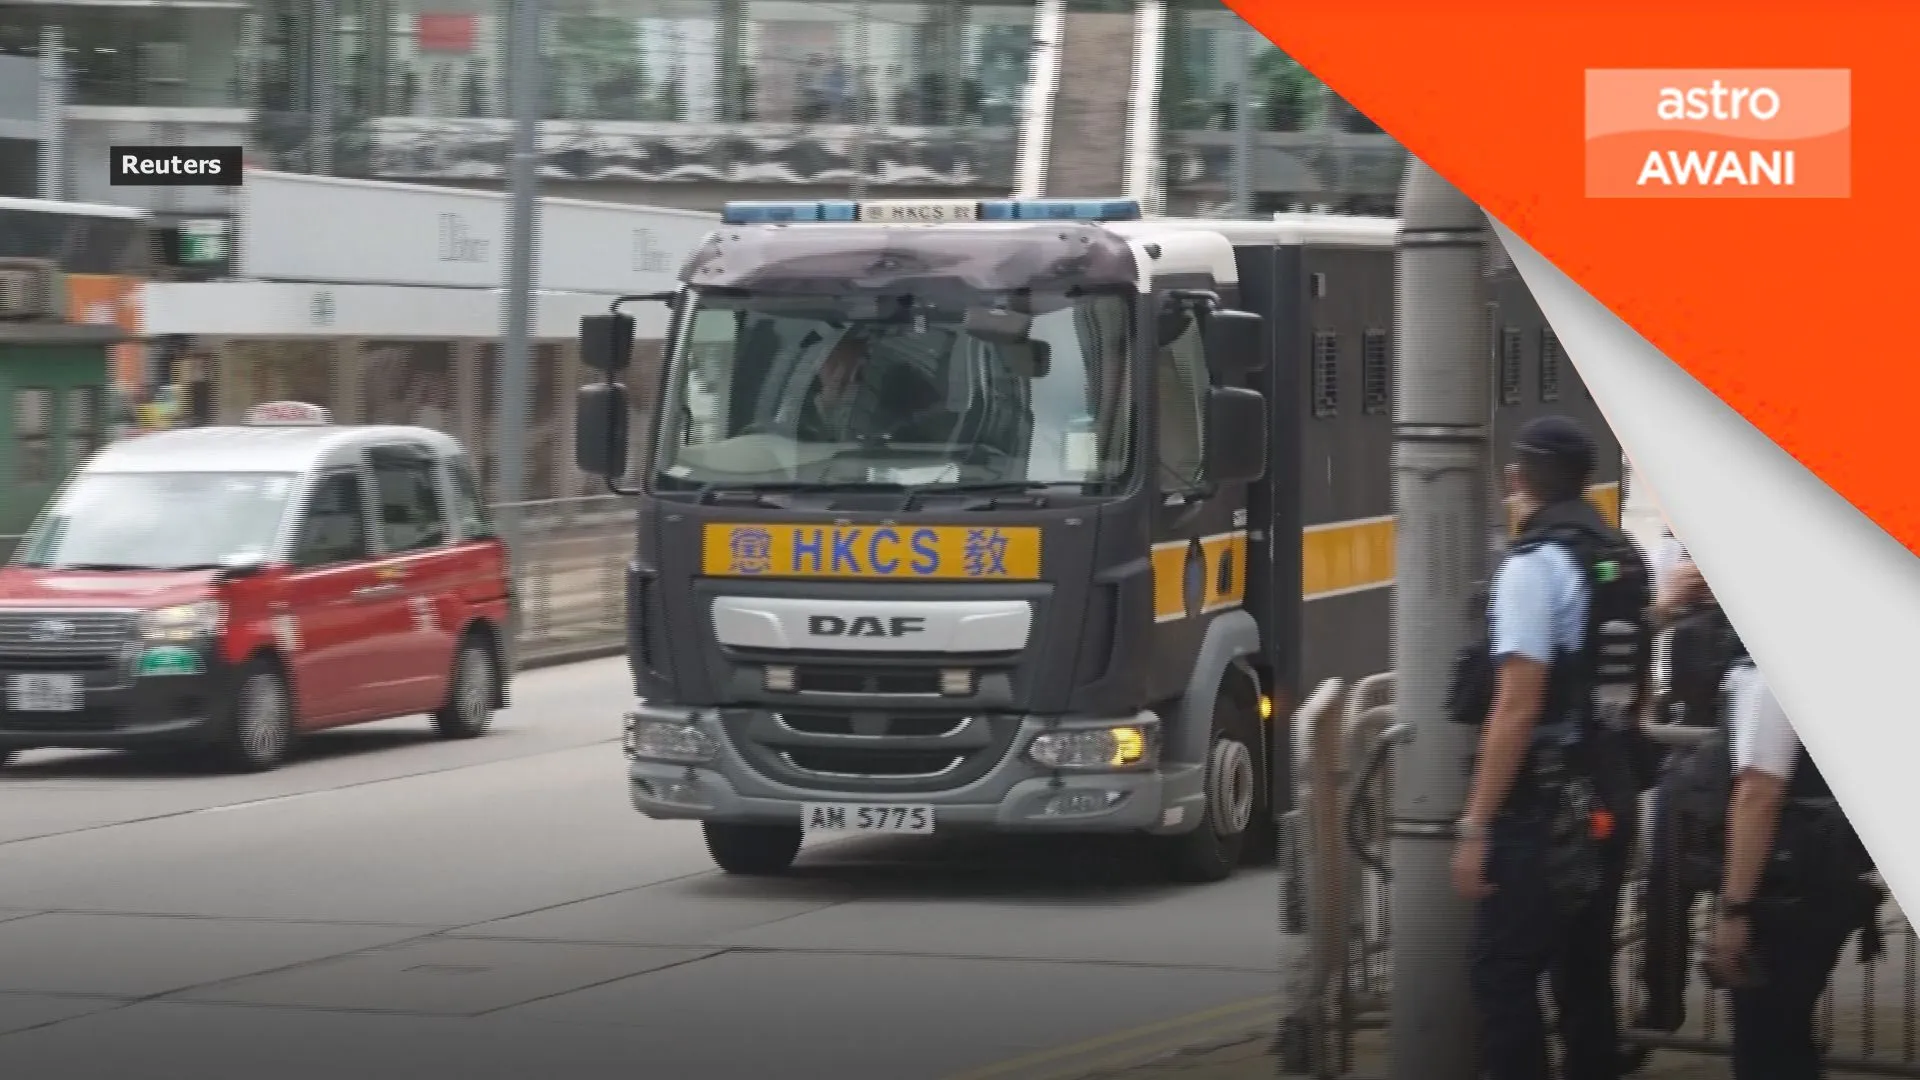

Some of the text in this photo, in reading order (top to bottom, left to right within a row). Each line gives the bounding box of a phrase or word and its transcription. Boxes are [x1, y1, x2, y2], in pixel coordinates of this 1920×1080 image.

[891, 205, 945, 220] HKCS
[792, 527, 941, 575] HKCS
[808, 614, 928, 637] DAF
[809, 806, 928, 830] AM 5775
